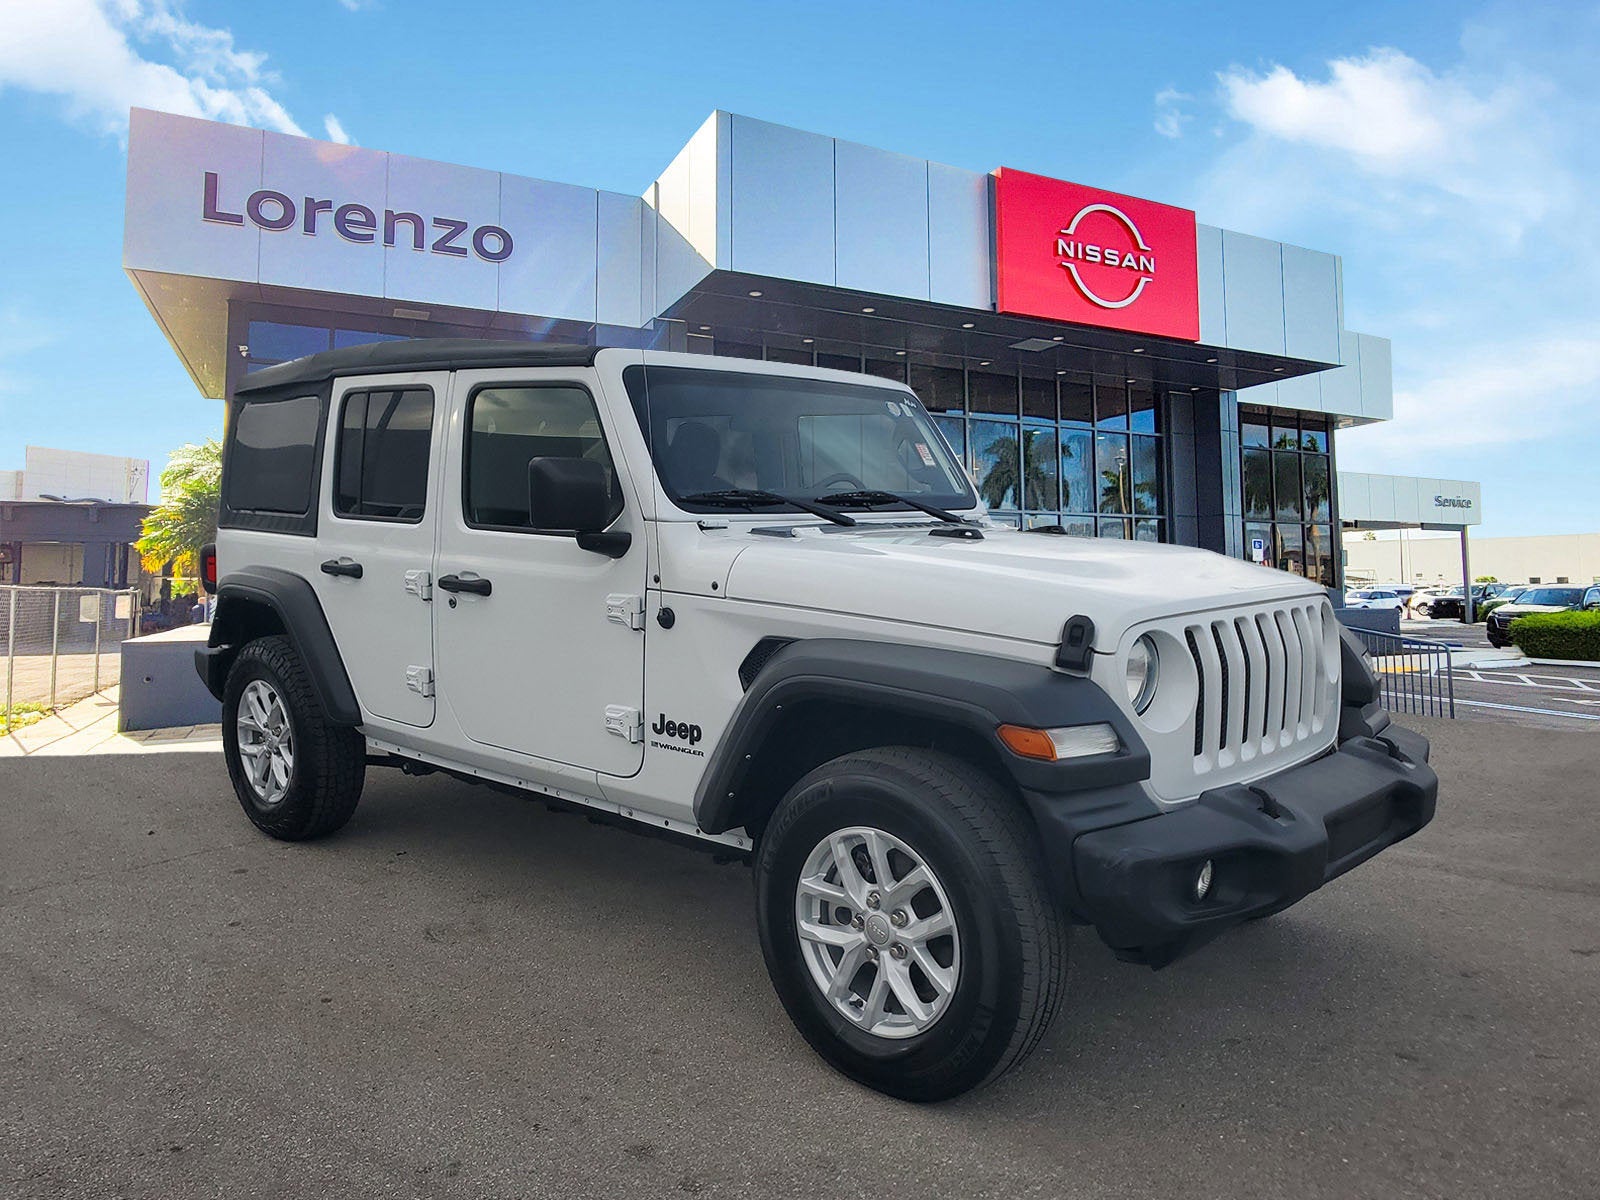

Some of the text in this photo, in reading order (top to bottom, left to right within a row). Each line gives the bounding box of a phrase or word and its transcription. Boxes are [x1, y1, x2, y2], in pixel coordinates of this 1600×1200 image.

[201, 170, 514, 263] Lorenzo
[1057, 239, 1155, 273] NISSAN
[1434, 495, 1472, 509] Service
[652, 713, 702, 746] Jeep
[658, 742, 705, 757] WRANGLER
